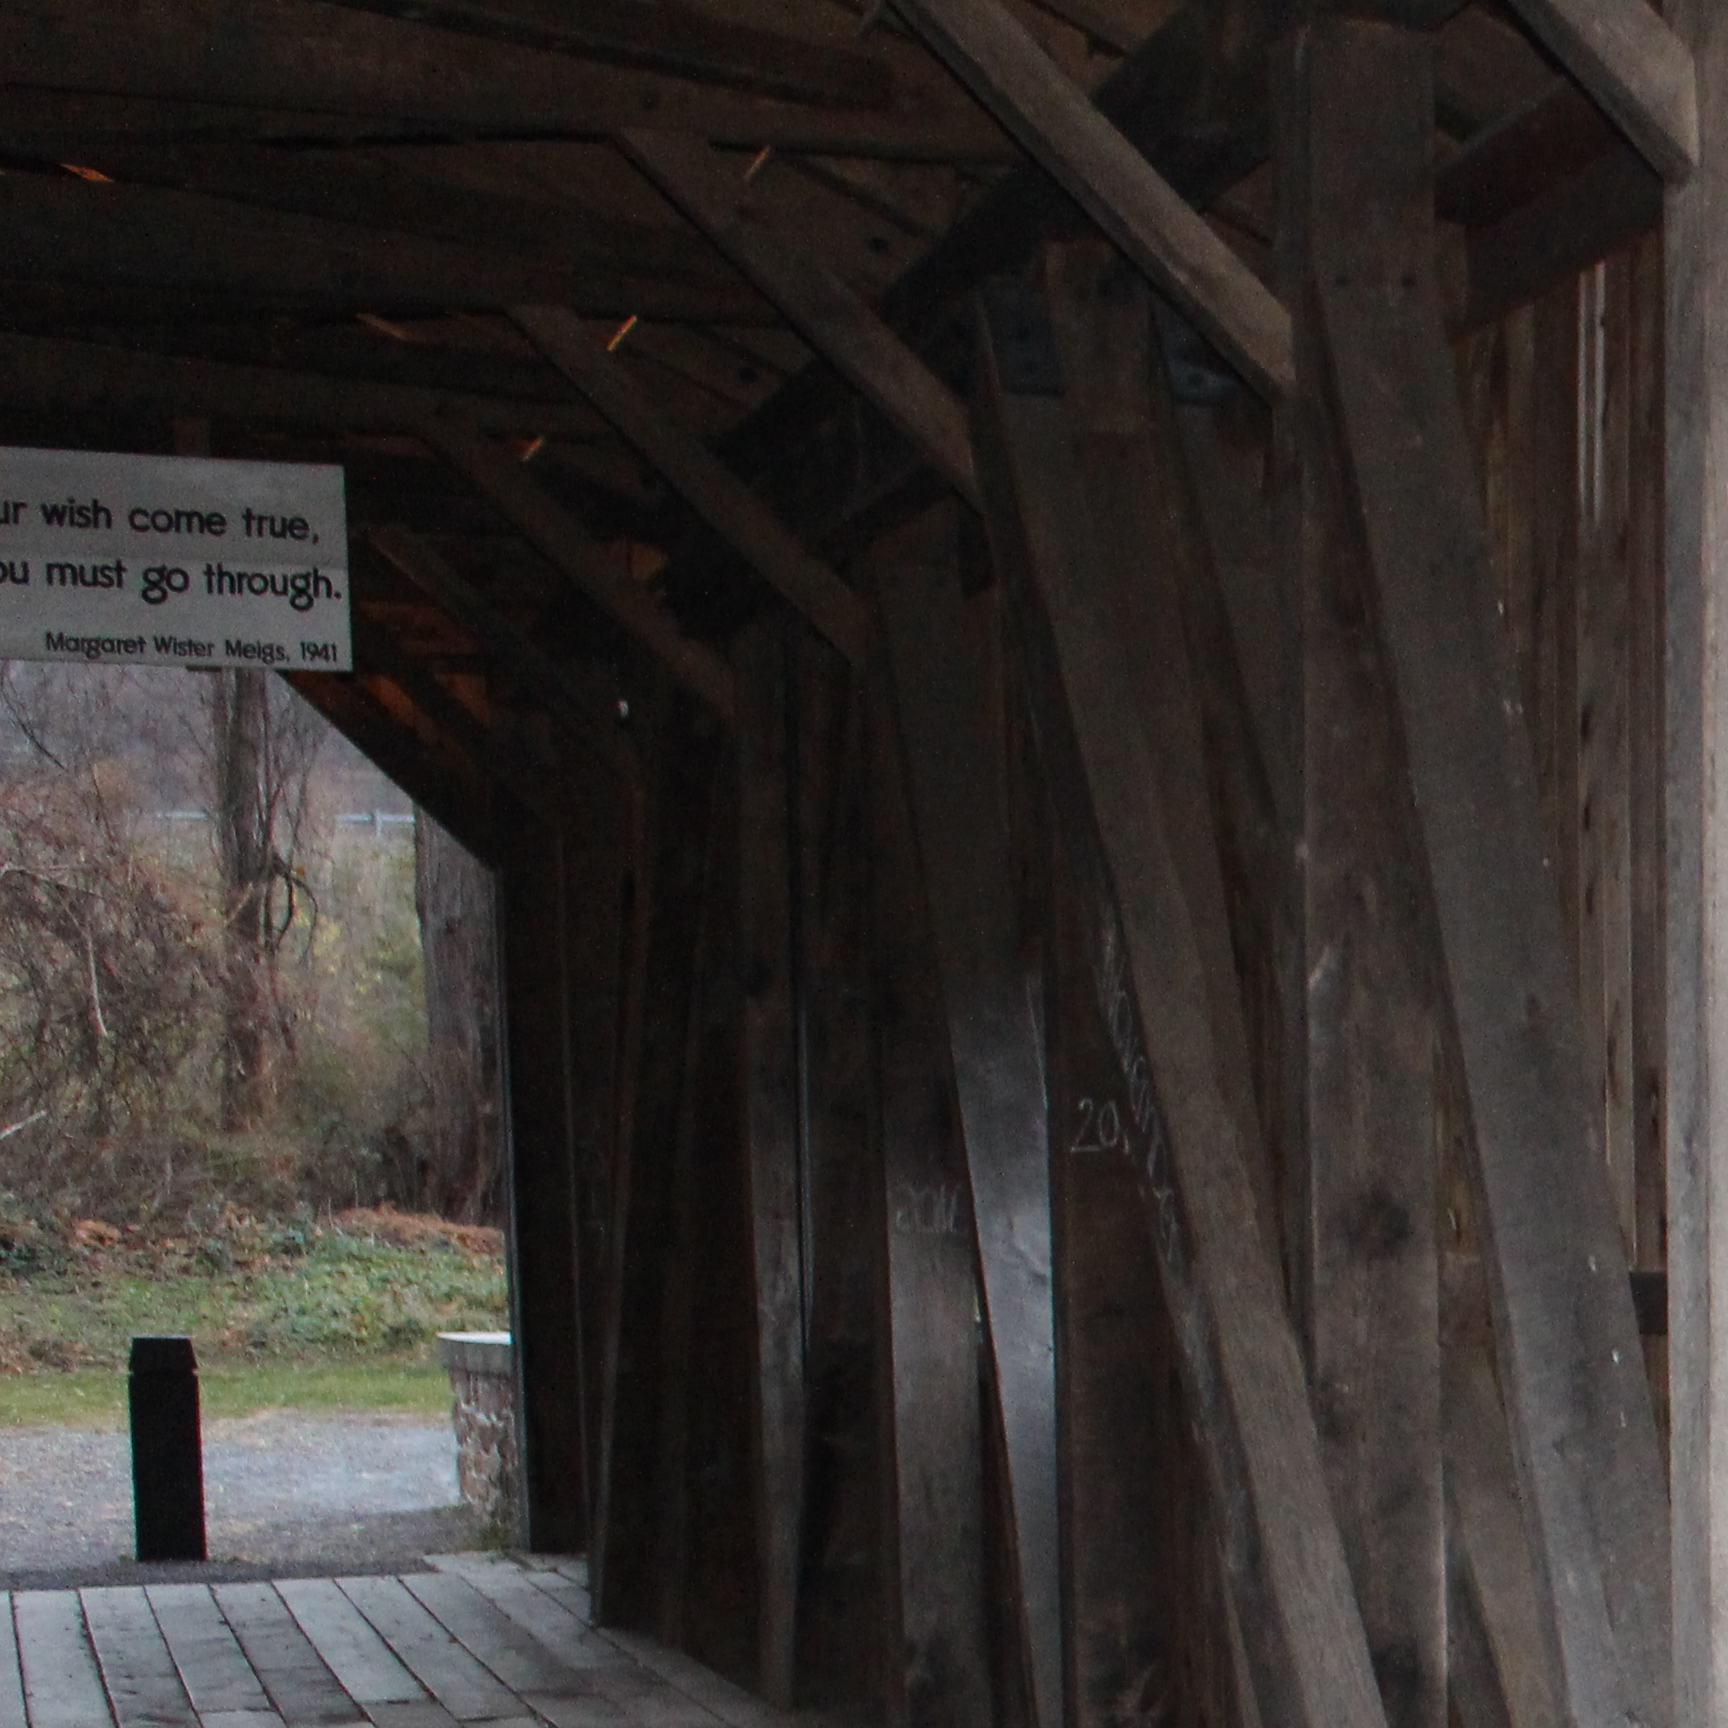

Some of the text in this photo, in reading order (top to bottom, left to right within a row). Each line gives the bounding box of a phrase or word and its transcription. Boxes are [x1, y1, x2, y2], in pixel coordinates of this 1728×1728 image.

[40, 496, 113, 530] wish
[128, 507, 227, 536] come
[241, 506, 320, 545] true,
[46, 558, 128, 589] must
[141, 564, 190, 605] go
[203, 562, 342, 612] through.
[45, 631, 338, 664] Margaret Wister Meigs, 1941
